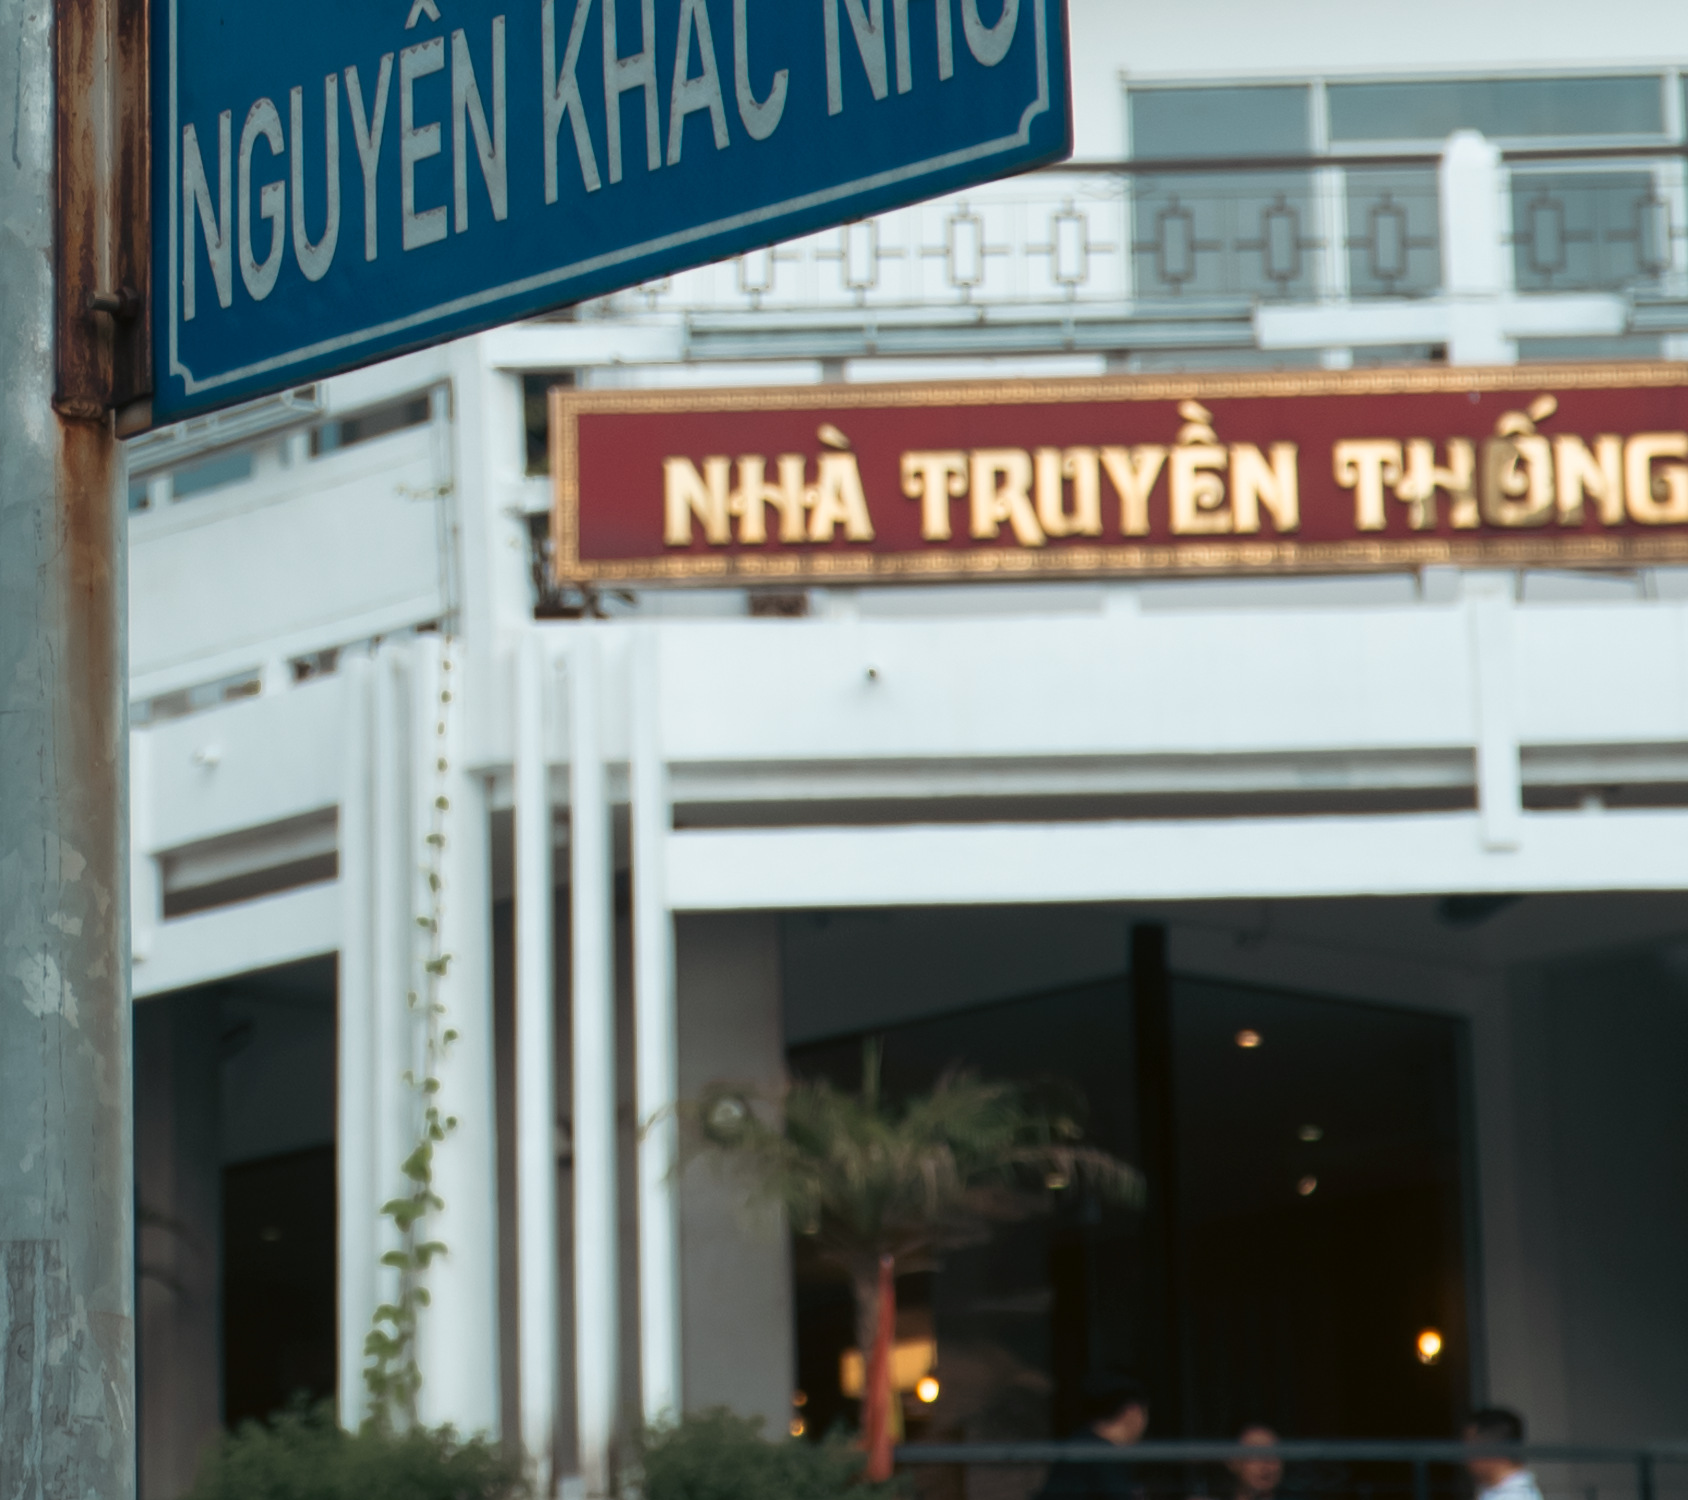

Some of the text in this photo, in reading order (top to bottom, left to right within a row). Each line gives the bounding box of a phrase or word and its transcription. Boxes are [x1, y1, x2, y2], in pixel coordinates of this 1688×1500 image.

[663, 394, 1688, 548] NHÀ TRUYỀN THỐNG
